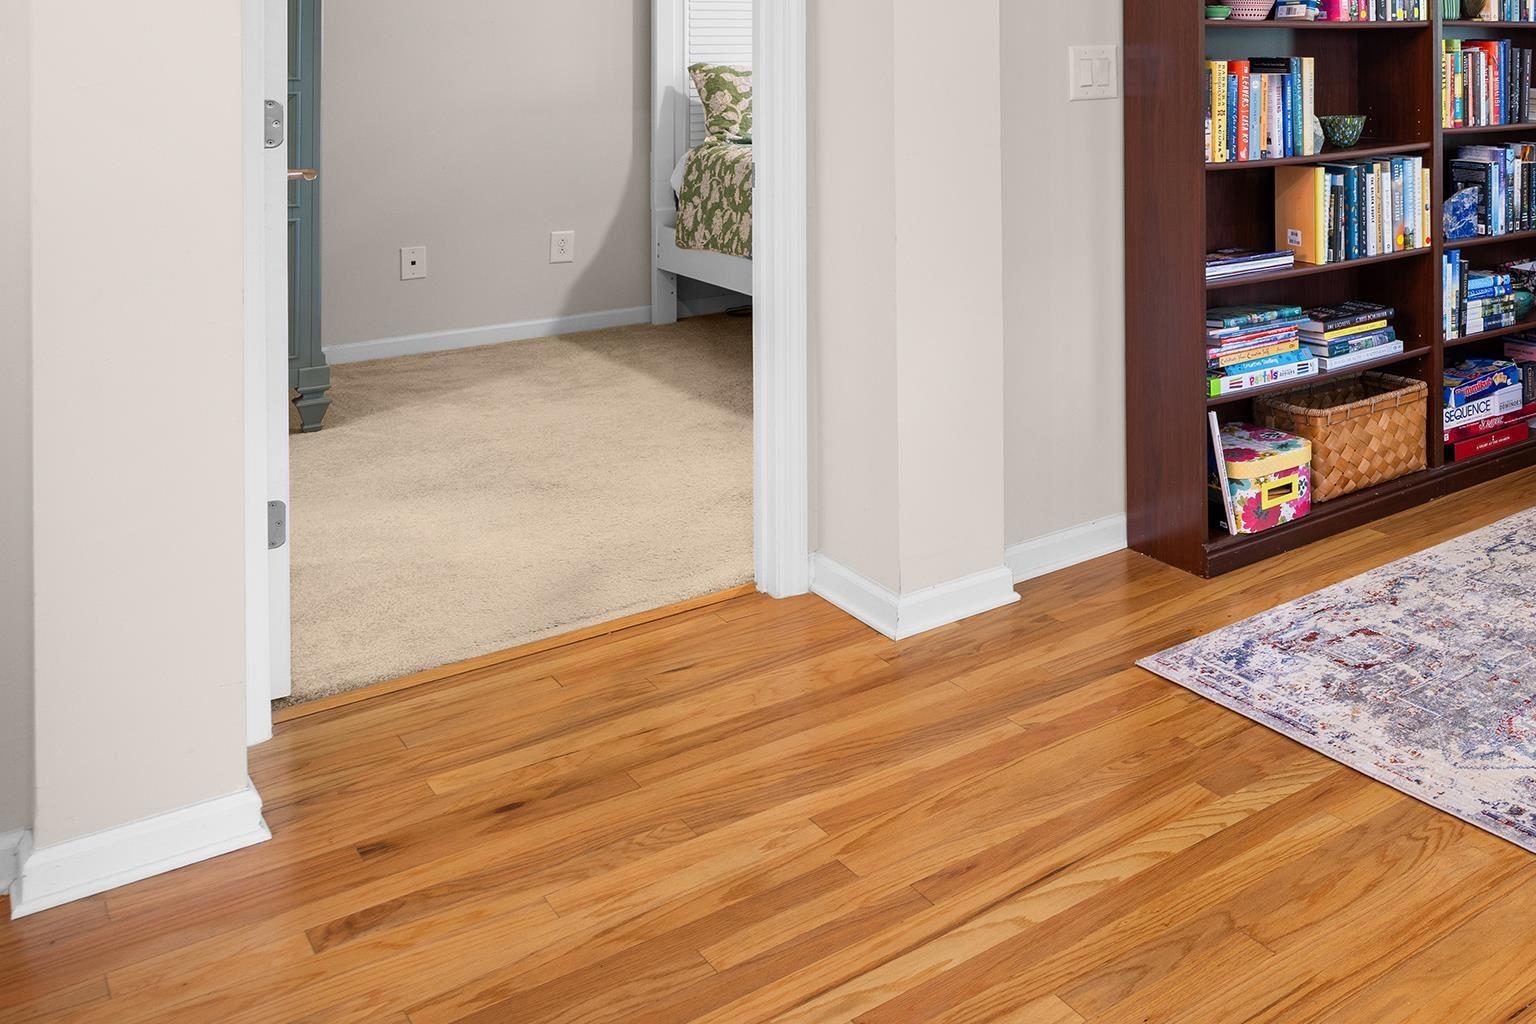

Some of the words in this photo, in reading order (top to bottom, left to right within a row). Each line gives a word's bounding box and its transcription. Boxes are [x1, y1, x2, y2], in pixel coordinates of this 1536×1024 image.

[1241, 75, 1249, 108] LEAVERS
[1242, 133, 1249, 143] KO
[1444, 400, 1491, 423] SEQUENCE
